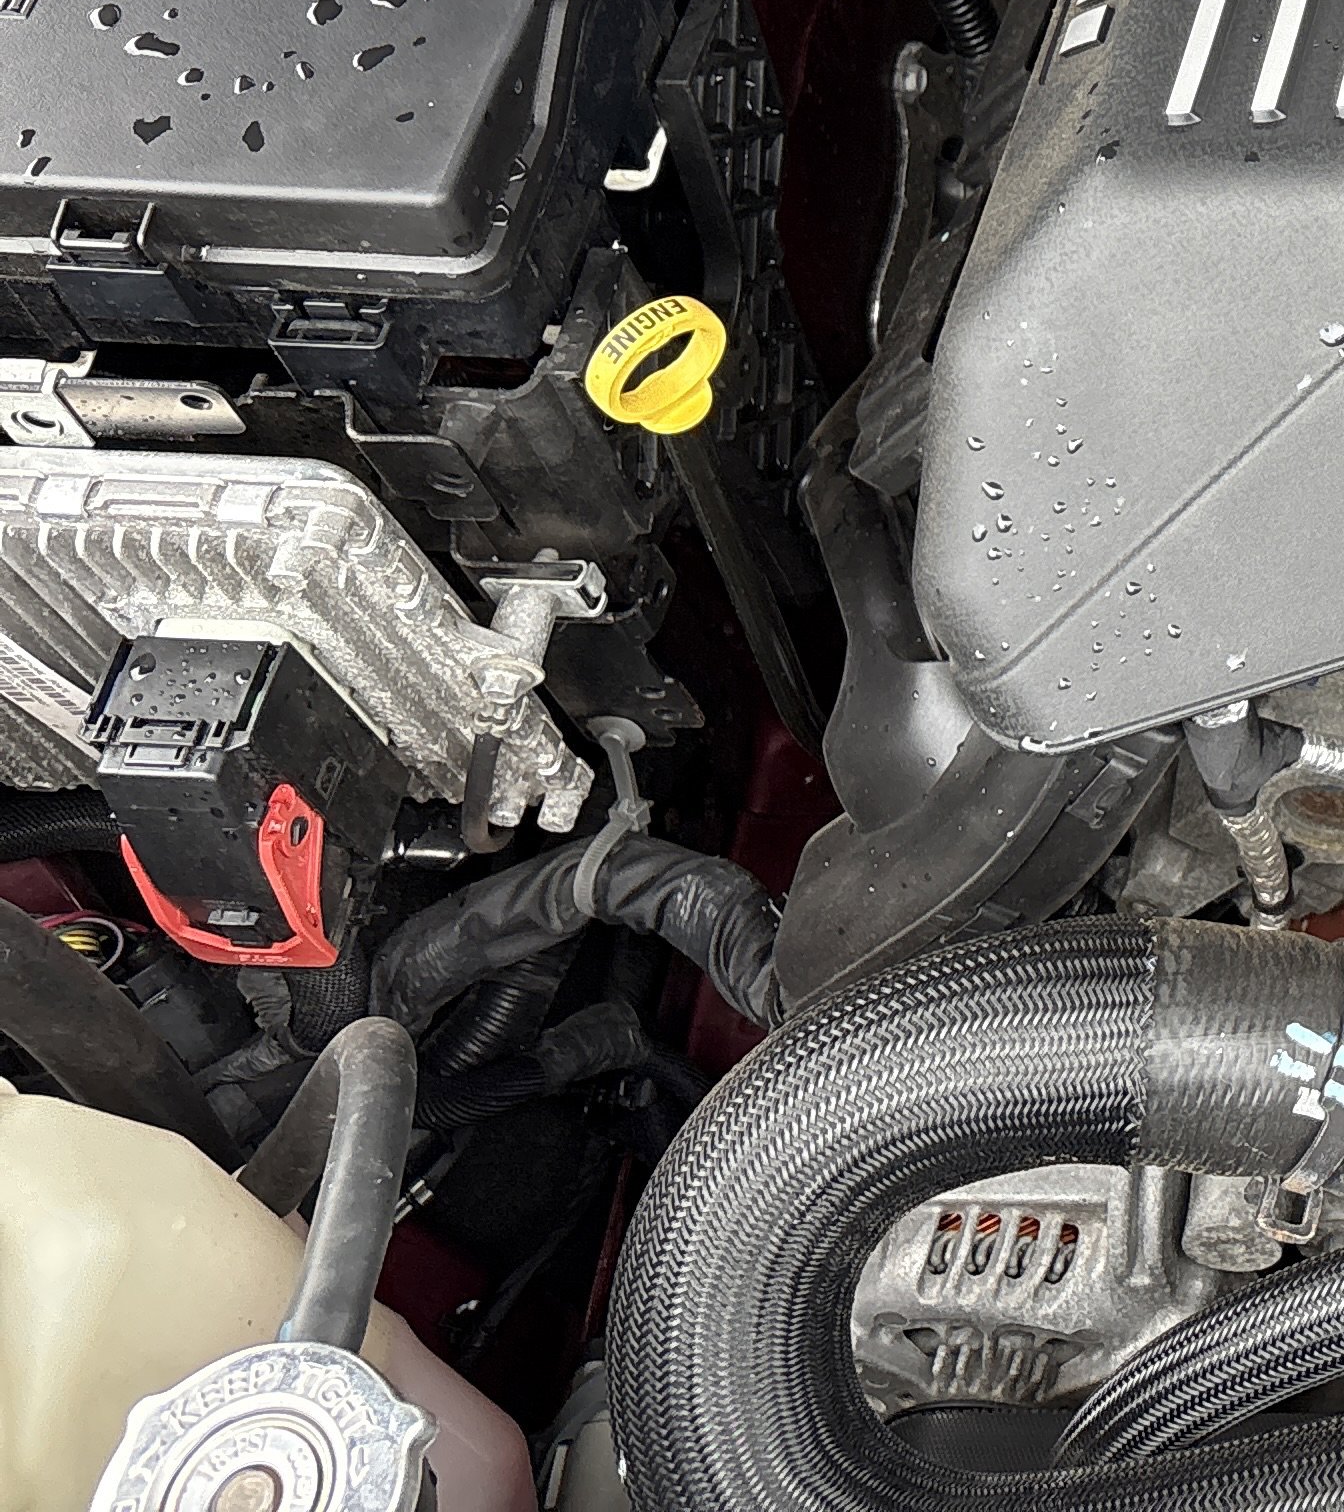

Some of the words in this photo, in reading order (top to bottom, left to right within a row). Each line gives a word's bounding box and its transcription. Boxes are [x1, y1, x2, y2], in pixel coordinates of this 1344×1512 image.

[601, 298, 688, 365] ENGINE
[160, 1357, 282, 1437] KEEP
[294, 1361, 392, 1442] TIGHT
